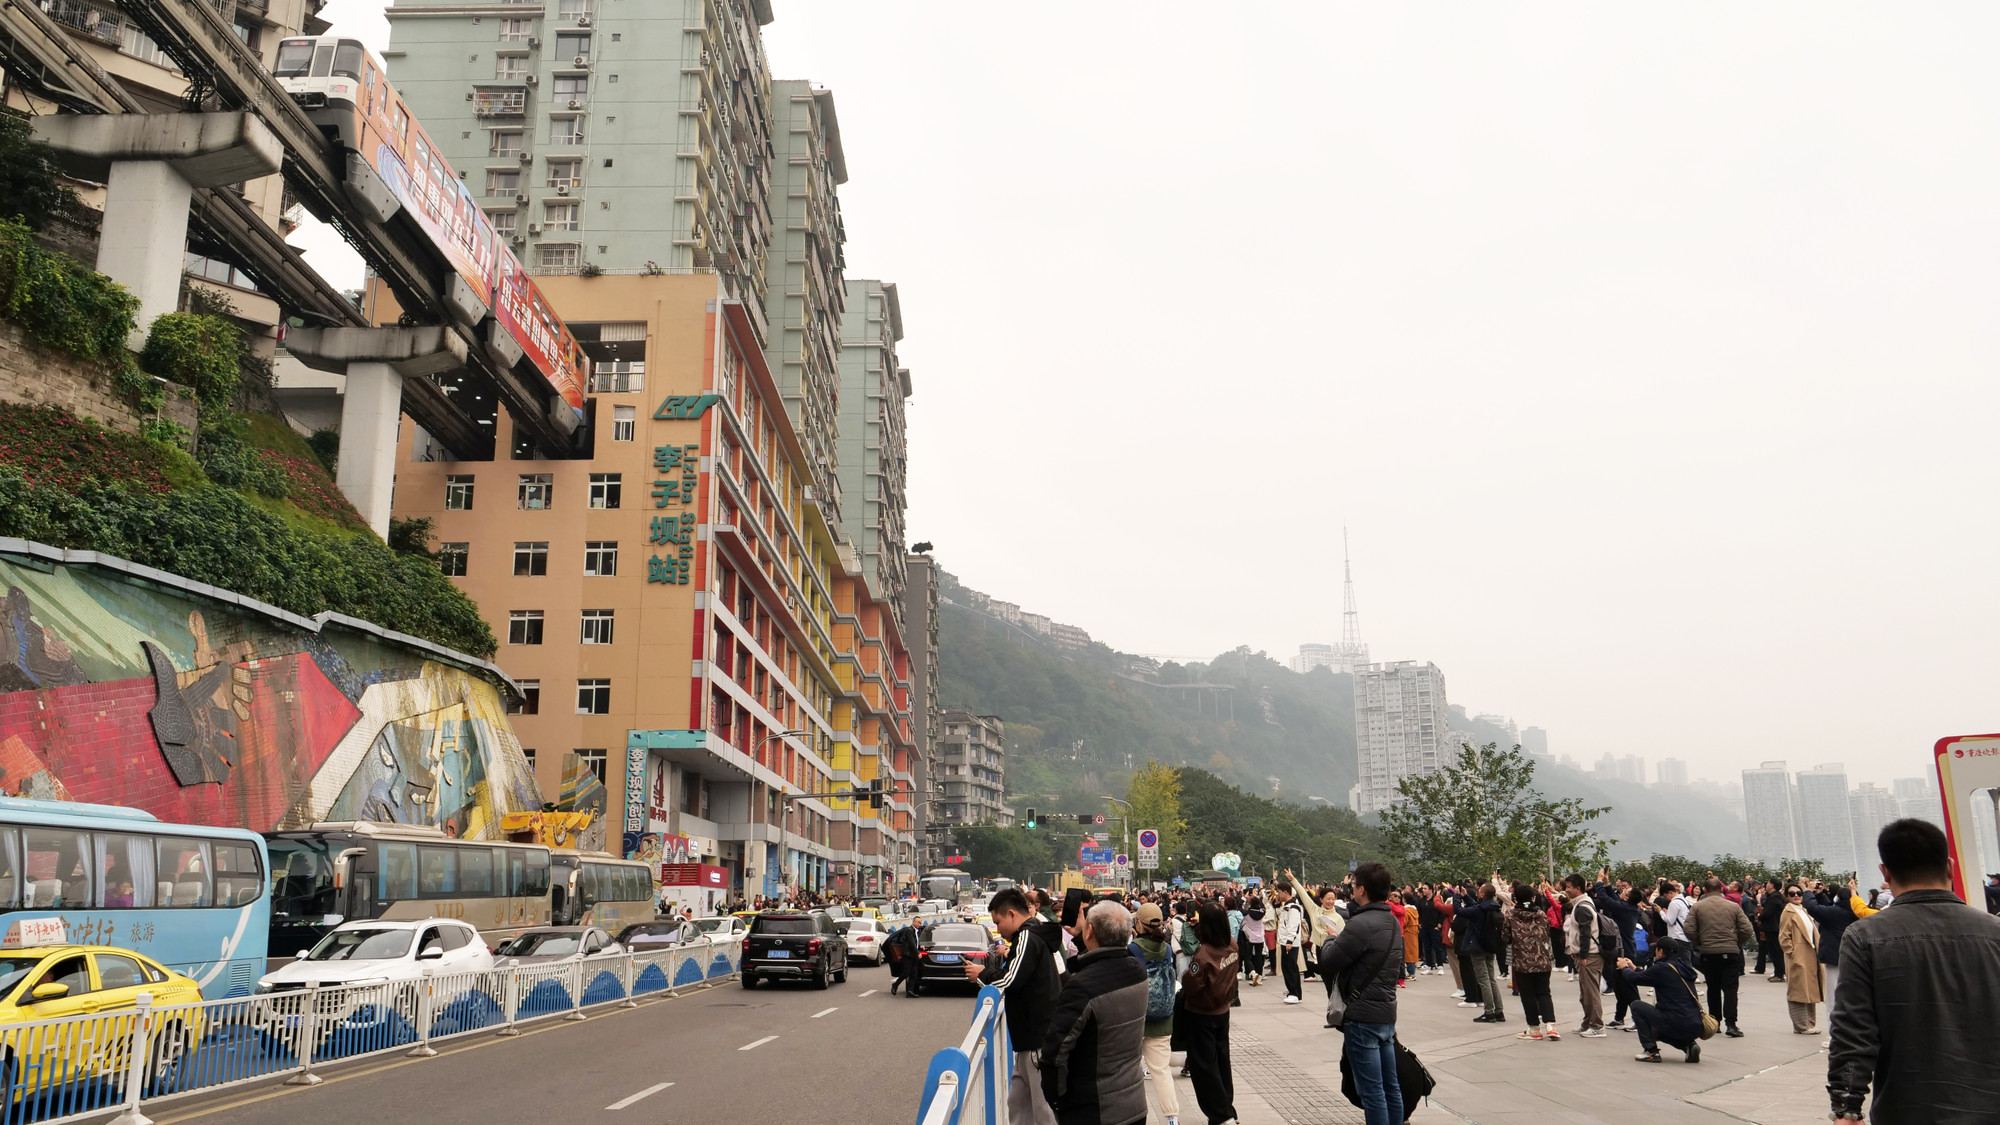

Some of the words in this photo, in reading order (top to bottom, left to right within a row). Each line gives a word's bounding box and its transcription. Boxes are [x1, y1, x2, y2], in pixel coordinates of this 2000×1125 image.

[681, 444, 699, 504] Liziba
[648, 444, 682, 585] 李子坝站
[678, 512, 696, 585] Station
[628, 748, 644, 832] 李子坝文创园
[130, 921, 154, 943] 旅游
[435, 902, 465, 919] VIP
